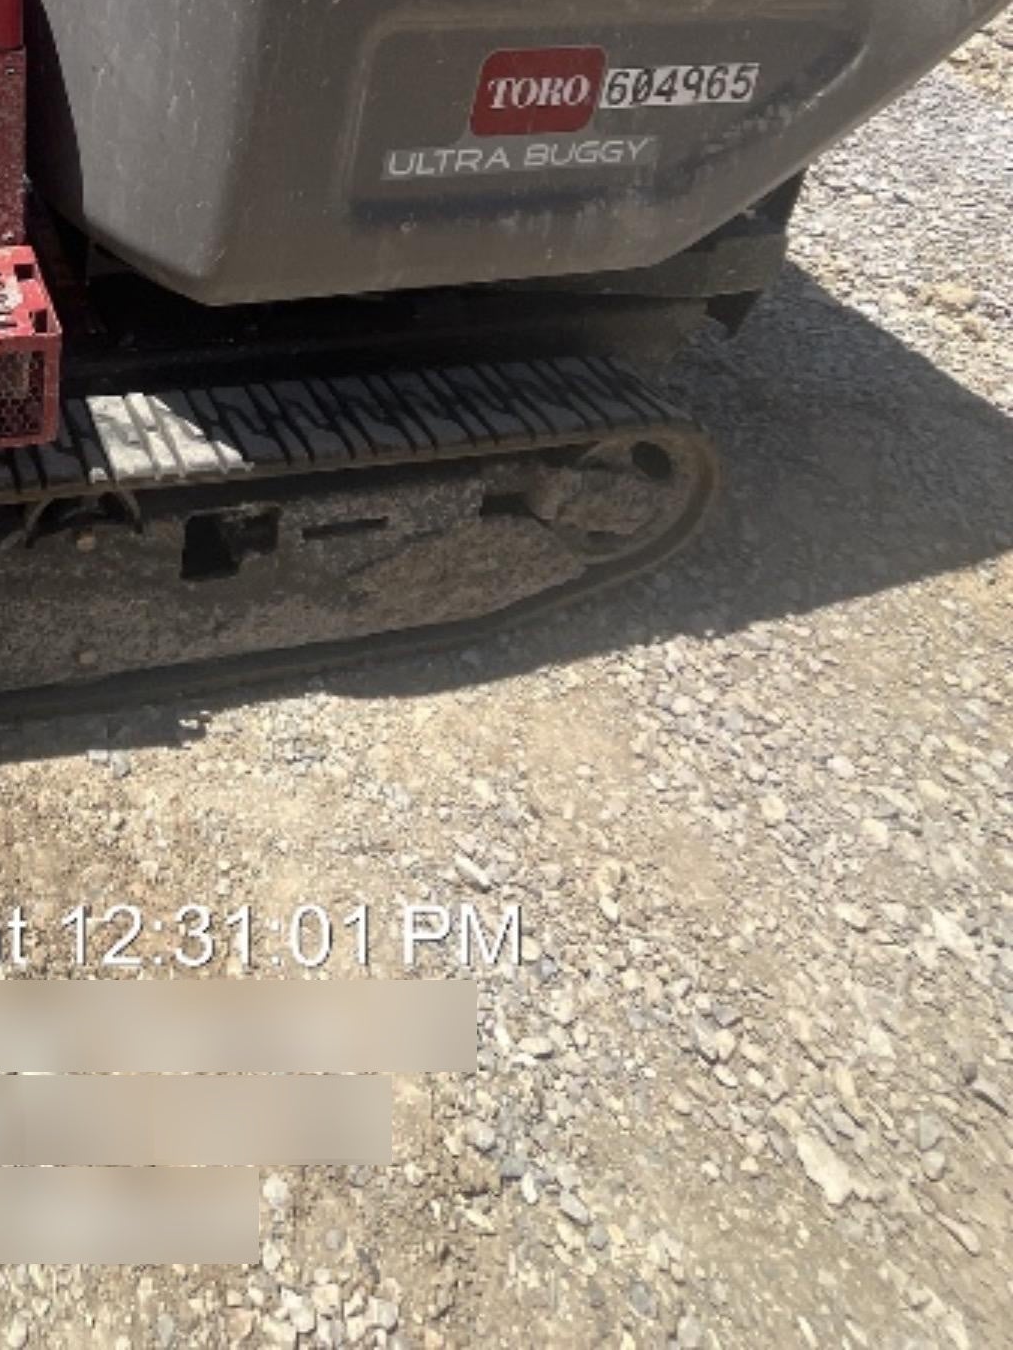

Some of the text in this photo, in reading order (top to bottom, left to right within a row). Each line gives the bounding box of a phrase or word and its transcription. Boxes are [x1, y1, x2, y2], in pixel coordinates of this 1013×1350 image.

[488, 74, 588, 110] TORO
[602, 64, 756, 106] 604965
[388, 140, 650, 176] ULTRA BUGGY
